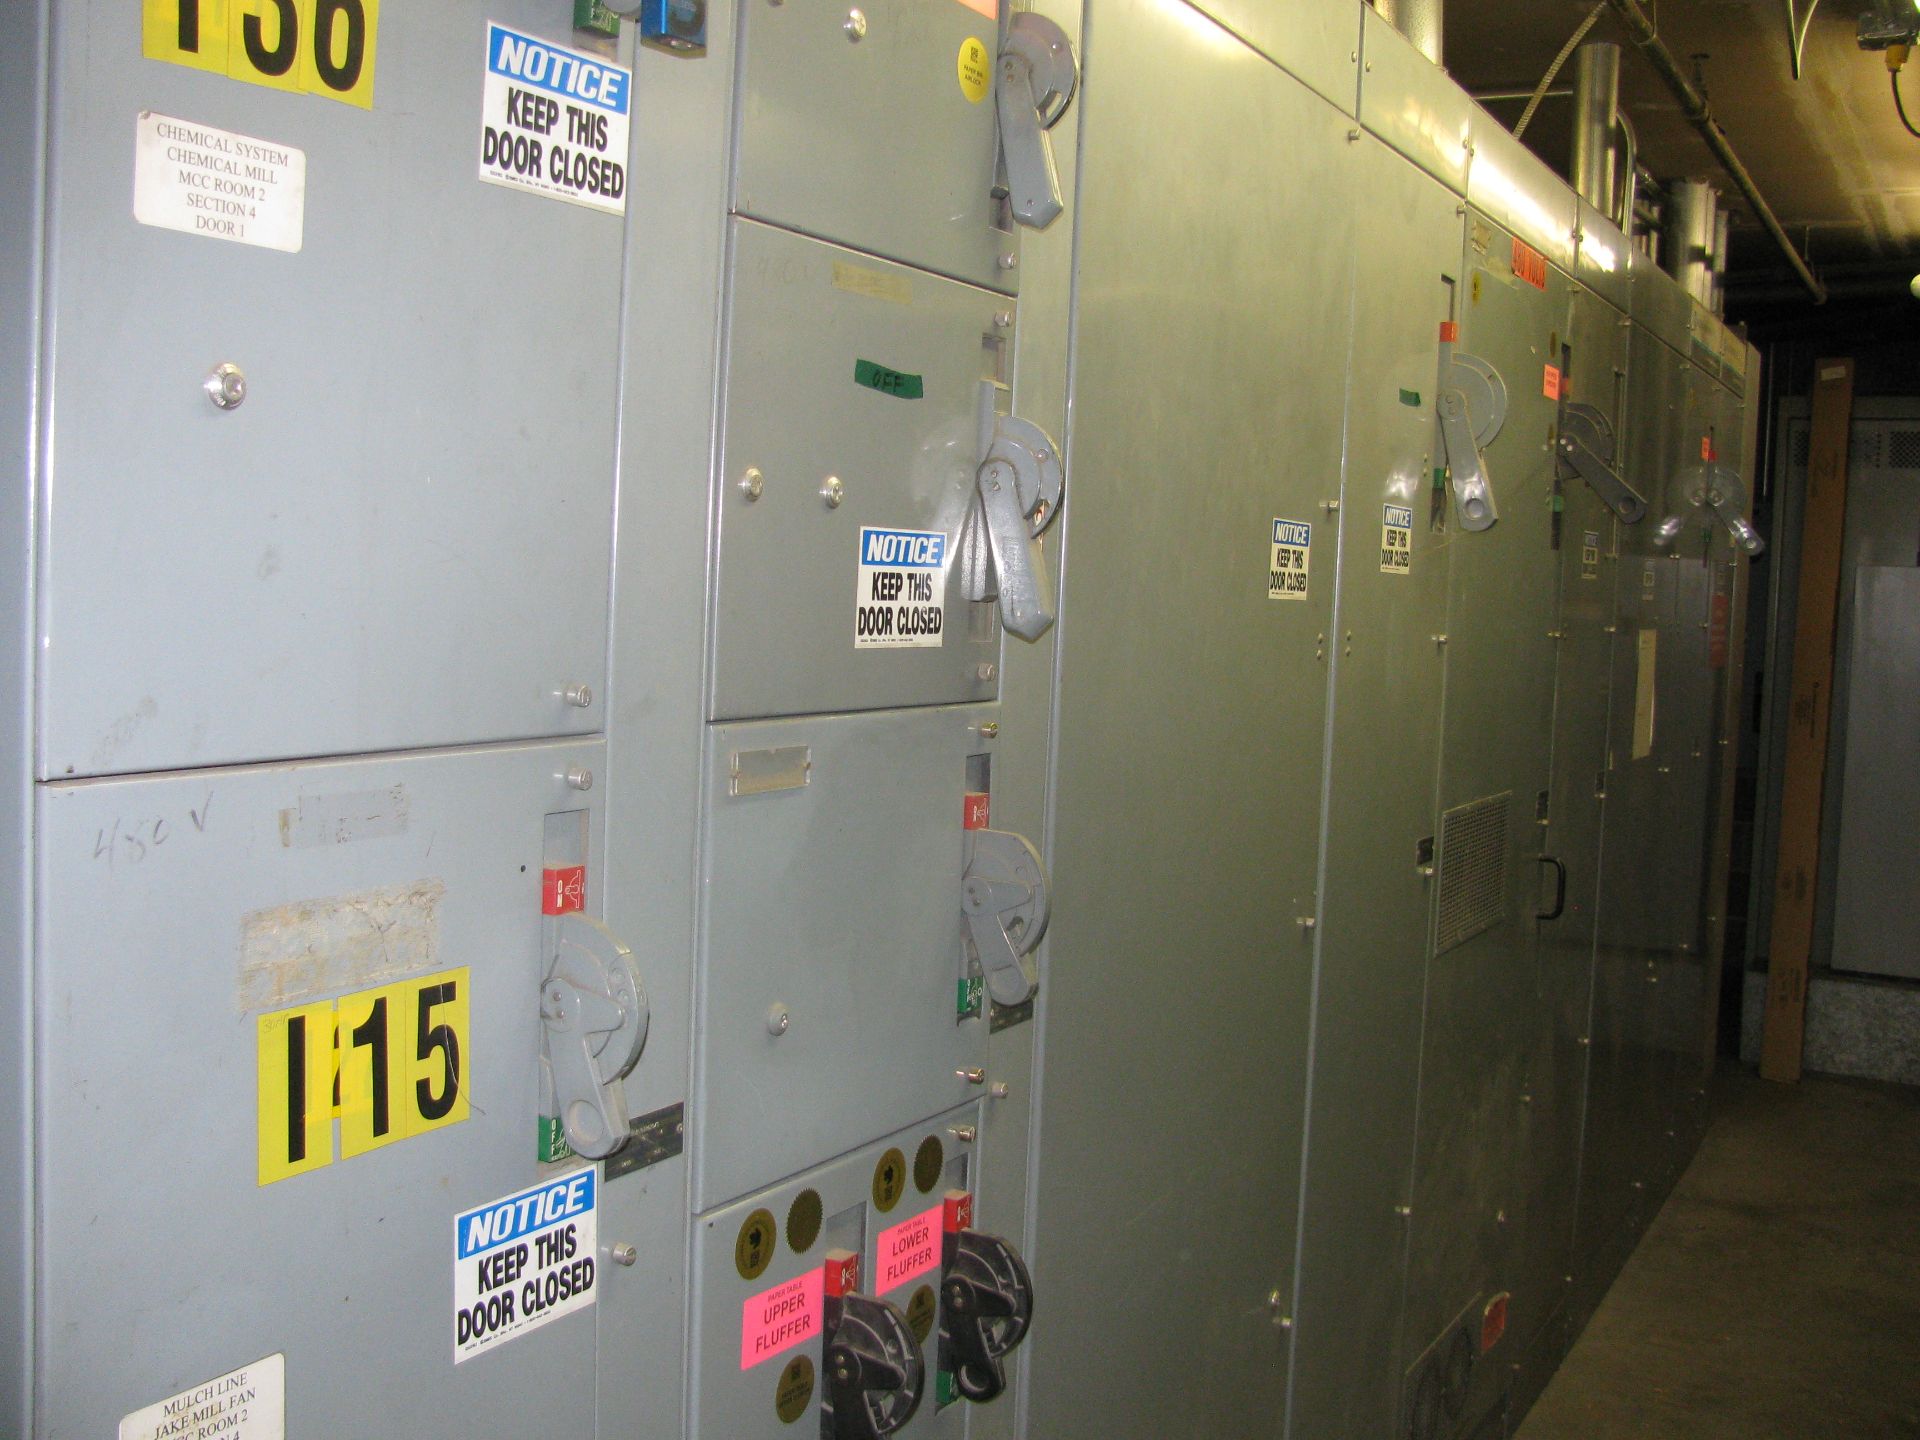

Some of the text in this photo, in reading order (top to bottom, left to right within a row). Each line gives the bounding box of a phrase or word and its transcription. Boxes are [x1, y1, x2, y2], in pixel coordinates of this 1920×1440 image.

[497, 36, 622, 107] NOTICE
[507, 87, 608, 152] KEEP THIS
[157, 123, 288, 167] CHEMICAL SYSTEM
[167, 147, 277, 184] CHEMICAL MILL
[483, 126, 542, 178] DOOR
[550, 146, 624, 199] CLOSED
[178, 170, 266, 201] MCC ROOM 2
[186, 193, 256, 219] SECTION 4
[196, 215, 245, 237] DOOR 1
[872, 369, 904, 393] OFF
[1385, 507, 1410, 526] NOTICE
[866, 533, 940, 564] NOTICE
[1275, 522, 1308, 544] NOTICE
[1277, 548, 1303, 569] KEEP THIS
[1382, 549, 1409, 567] DOOR CLOSED
[872, 572, 932, 602] KEEP THIS
[1270, 571, 1306, 592] DOOR CLOSED
[858, 606, 941, 636] DOOR CLOSED
[466, 1176, 588, 1252] NOTICE
[892, 1226, 929, 1256] LOWER
[478, 1223, 577, 1295] KEEP THIS
[887, 1247, 932, 1281] FLUFFER
[458, 1289, 515, 1346] DOOR
[522, 1256, 595, 1317] CLOSED
[768, 1281, 802, 1302] PAPER TABLE
[764, 1292, 805, 1325] UPPER
[756, 1314, 810, 1354] FLUFFER
[163, 1372, 248, 1418] MULCH LINE
[154, 1387, 257, 1440] JAKE MILL FAN
[199, 1413, 238, 1440] ROOM
[241, 1408, 248, 1422] 2
